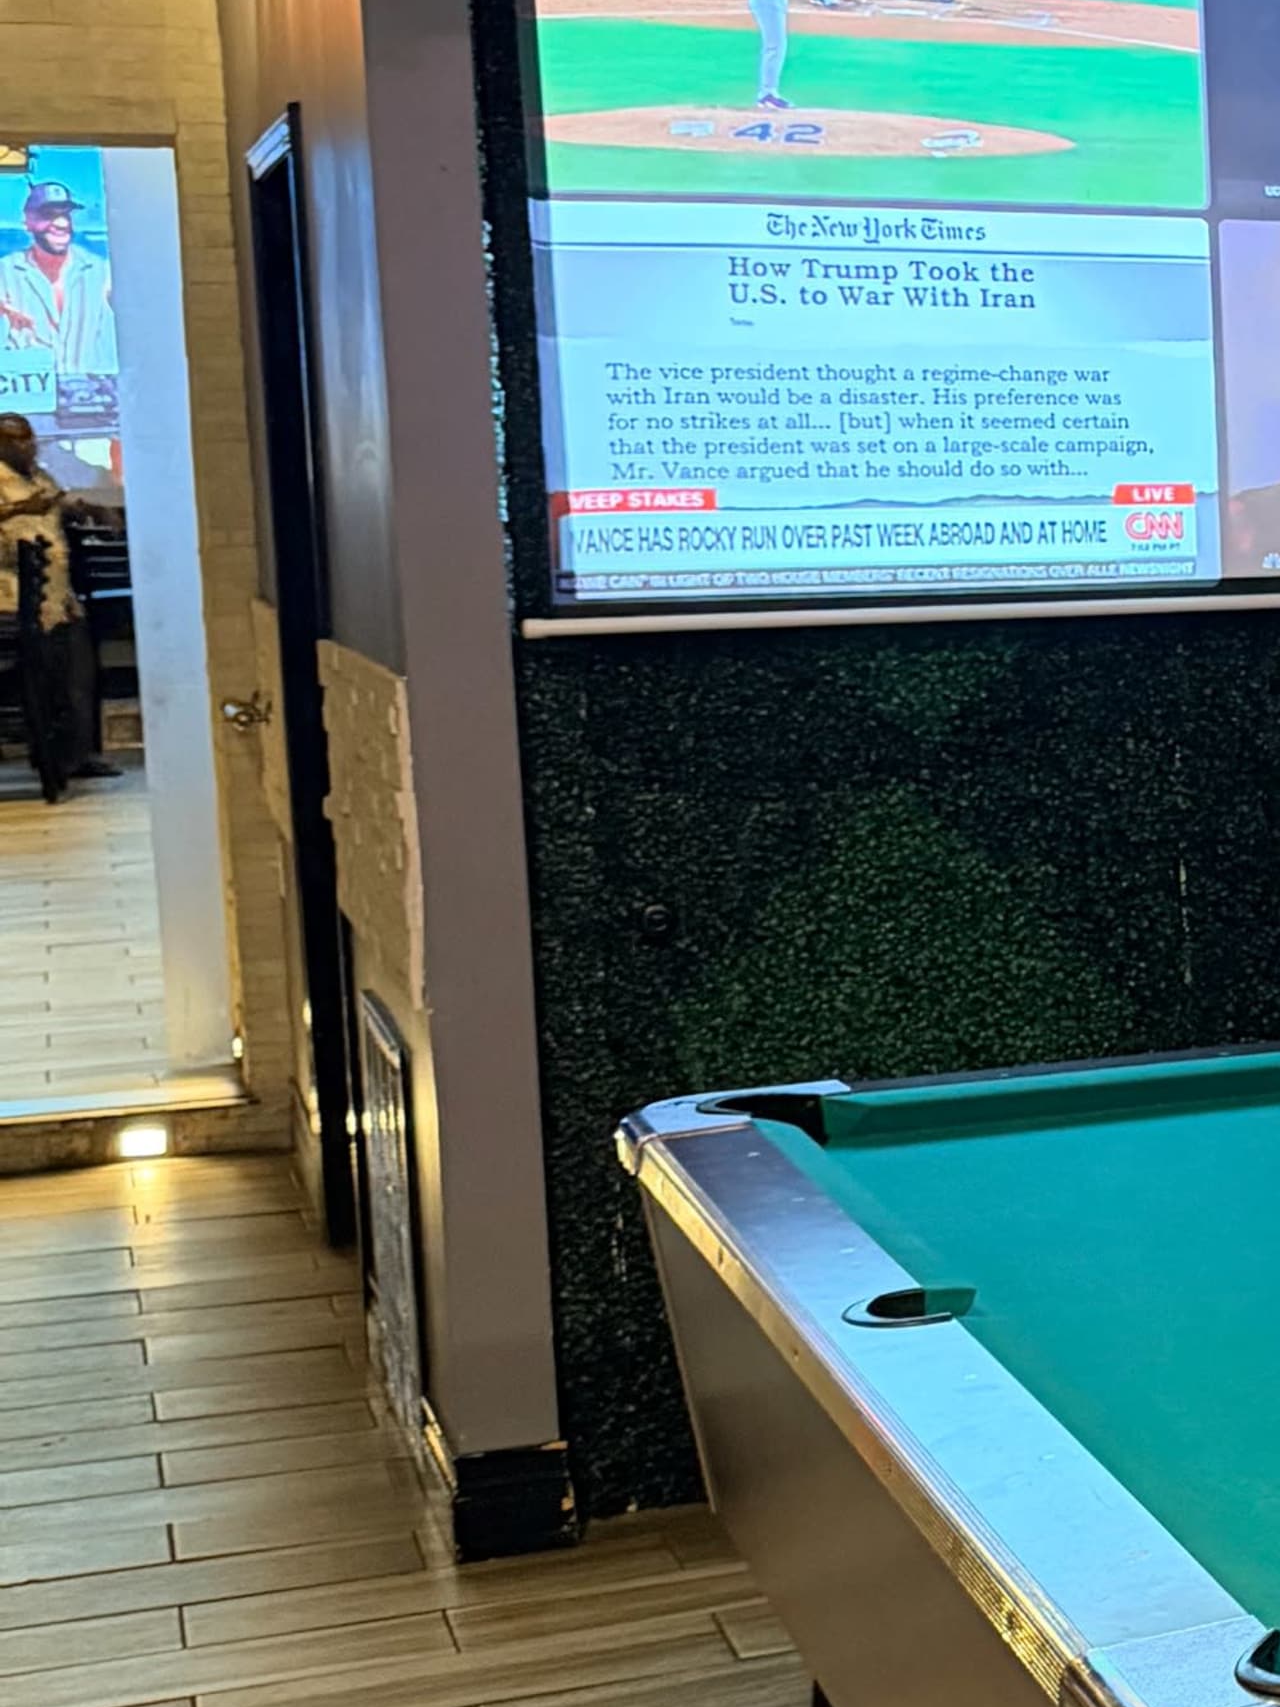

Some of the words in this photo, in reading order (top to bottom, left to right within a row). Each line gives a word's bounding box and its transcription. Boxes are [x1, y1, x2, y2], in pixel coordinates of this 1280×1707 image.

[728, 121, 824, 145] 42
[766, 213, 806, 240] The
[811, 215, 858, 238] New
[863, 216, 917, 244] York
[921, 217, 987, 241] Times
[728, 256, 792, 277] How
[801, 258, 898, 284] Trump
[909, 260, 979, 282] Took
[990, 262, 1035, 283] the
[728, 282, 787, 305] U.S.
[799, 286, 828, 306] to
[838, 286, 895, 307] War
[903, 286, 970, 308] With
[980, 288, 1036, 309] Iran
[605, 362, 652, 381] The
[659, 362, 704, 380] vice
[711, 362, 809, 385] president
[816, 363, 898, 385] thought
[903, 368, 915, 382] a
[922, 364, 1068, 385] regime-change
[1074, 368, 1111, 383] war
[607, 387, 657, 406] with
[664, 386, 711, 405] Iran
[717, 386, 781, 405] would
[787, 387, 813, 405] be
[819, 392, 832, 406] a
[839, 387, 926, 406] disaster.
[932, 387, 968, 406] His
[973, 388, 1079, 410] preference
[1084, 393, 1123, 406] was
[608, 412, 639, 431] for
[646, 416, 674, 430] no
[680, 411, 751, 431] strikes
[757, 414, 779, 430] at
[785, 411, 832, 431] all...
[839, 410, 892, 435] [but]
[899, 411, 954, 430] when
[960, 411, 975, 430] it
[981, 412, 1056, 430] seemed
[1062, 411, 1130, 430] certain
[609, 438, 656, 455] that
[662, 437, 698, 455] the
[704, 435, 805, 460] president
[810, 440, 851, 454] was
[857, 438, 887, 454] set
[893, 440, 919, 454] on
[925, 440, 937, 454] a
[943, 436, 1049, 457] large-scale
[1055, 436, 1155, 457] campaign,
[611, 462, 654, 481] Mr.
[661, 461, 731, 480] Vance
[736, 462, 810, 484] argued
[816, 462, 859, 479] that
[865, 460, 891, 478] he
[897, 460, 963, 478] should
[969, 460, 995, 477] do
[1000, 463, 1022, 477] so
[1027, 459, 1089, 477] with...
[569, 492, 622, 510] VEEP
[628, 491, 704, 508] STAKES
[1132, 487, 1176, 502] LIVE
[576, 527, 633, 554] VANCE
[637, 526, 674, 551] HAS
[679, 525, 737, 552] ROCKY
[742, 524, 777, 550] RUN
[782, 524, 827, 549] OVER
[832, 523, 874, 548] PAST
[878, 521, 923, 547] WEEK
[930, 521, 995, 546] ABROAD
[1002, 520, 1033, 544] AND
[1037, 520, 1057, 544] AT
[1061, 519, 1107, 543] HOME
[1124, 511, 1184, 540] CNN
